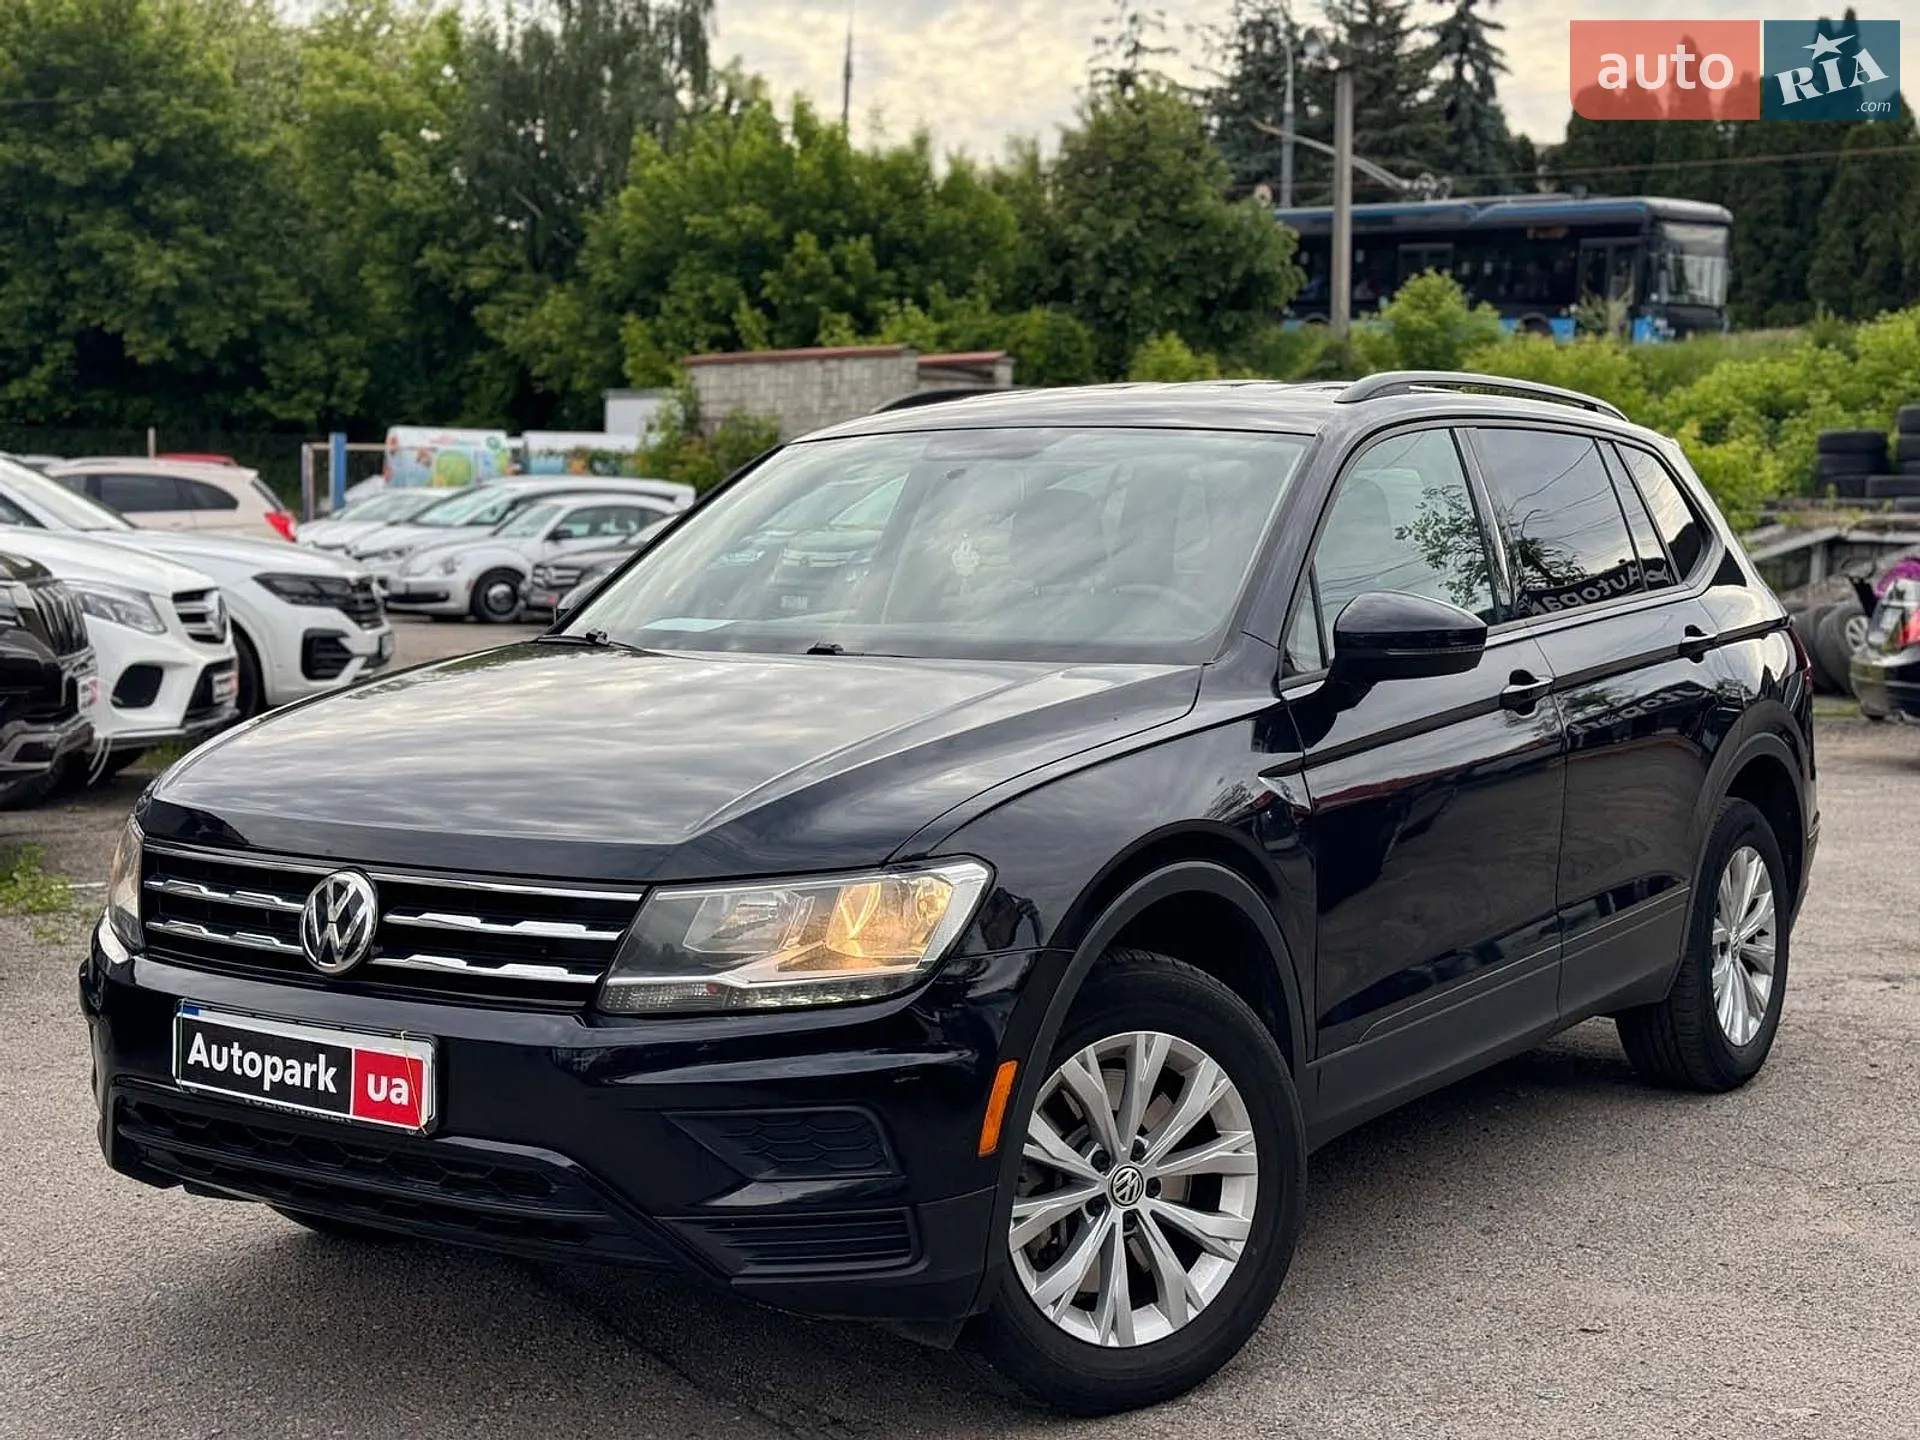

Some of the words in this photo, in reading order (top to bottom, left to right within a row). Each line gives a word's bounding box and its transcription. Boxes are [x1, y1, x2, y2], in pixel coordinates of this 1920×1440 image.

[303, 871, 375, 972] VW
[187, 1032, 337, 1094] Autopark
[367, 1072, 409, 1106] ua
